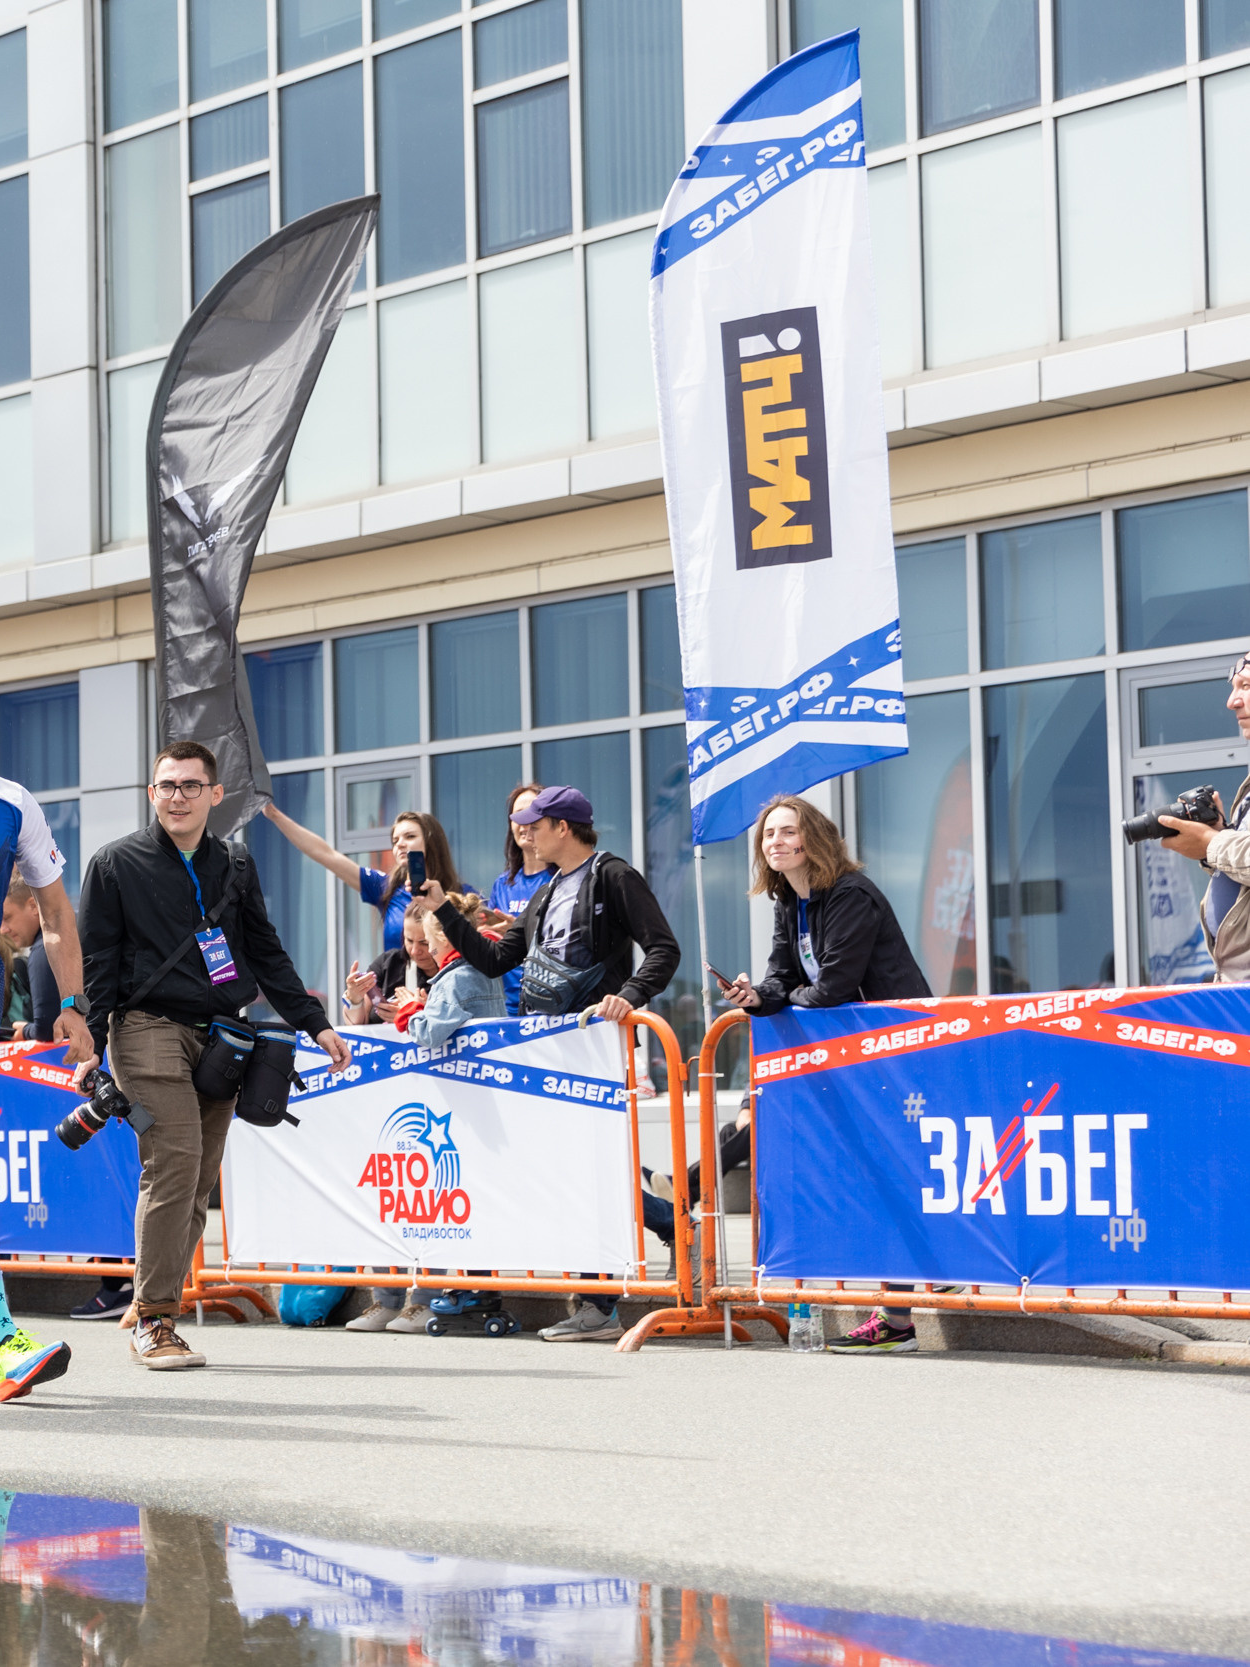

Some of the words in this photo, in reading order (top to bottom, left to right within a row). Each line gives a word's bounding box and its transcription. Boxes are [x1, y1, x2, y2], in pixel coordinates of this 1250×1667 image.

[688, 118, 858, 240] ЗАБЕГ.РФ
[738, 327, 814, 550] МАТЧ!
[688, 671, 833, 775] АБЕГ.РФ
[390, 1030, 488, 1070] ЗАБЕГ.РФ
[753, 1048, 829, 1079] БЕГ.РФ
[860, 1017, 970, 1055] ЗАБЕГ.РФ
[1004, 988, 1126, 1024] ЗАБЕГ.РФ
[1116, 1022, 1238, 1056] ЗАБЕГ.РФ
[357, 1152, 429, 1188] АВТО
[379, 1188, 471, 1224] РАДИО
[402, 1227, 472, 1241] ВЛАДИВОСТОК
[1101, 1208, 1148, 1253] .рф
